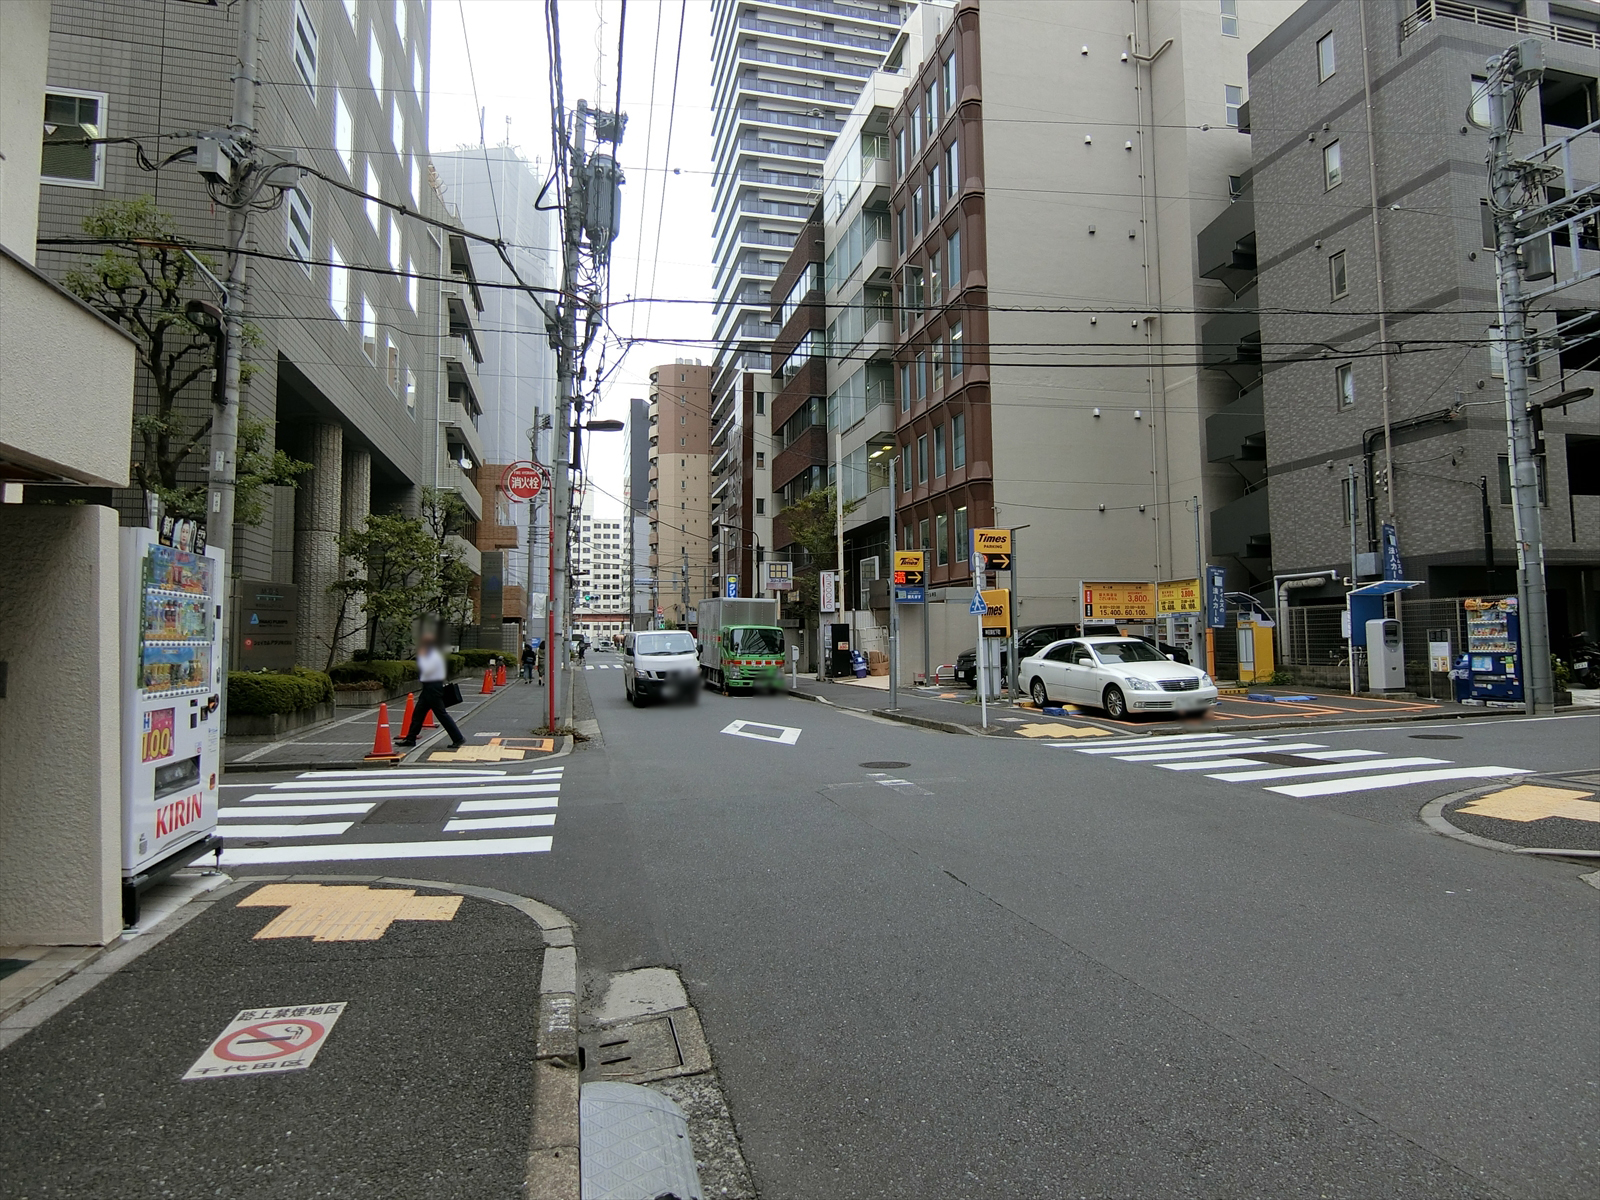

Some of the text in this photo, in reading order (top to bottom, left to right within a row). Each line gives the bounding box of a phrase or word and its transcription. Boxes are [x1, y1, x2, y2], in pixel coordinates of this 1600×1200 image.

[511, 476, 540, 489] 消火栓
[978, 533, 1007, 543] Times
[899, 557, 920, 566] Times
[1388, 547, 1399, 581] 法人カー
[825, 573, 833, 610] KIMOONO
[982, 602, 1004, 616] imes
[141, 727, 171, 761] 100
[155, 791, 203, 839] KIRIN
[235, 1003, 342, 1022] 路上禁煙地区
[193, 1058, 306, 1075] 千代田区
